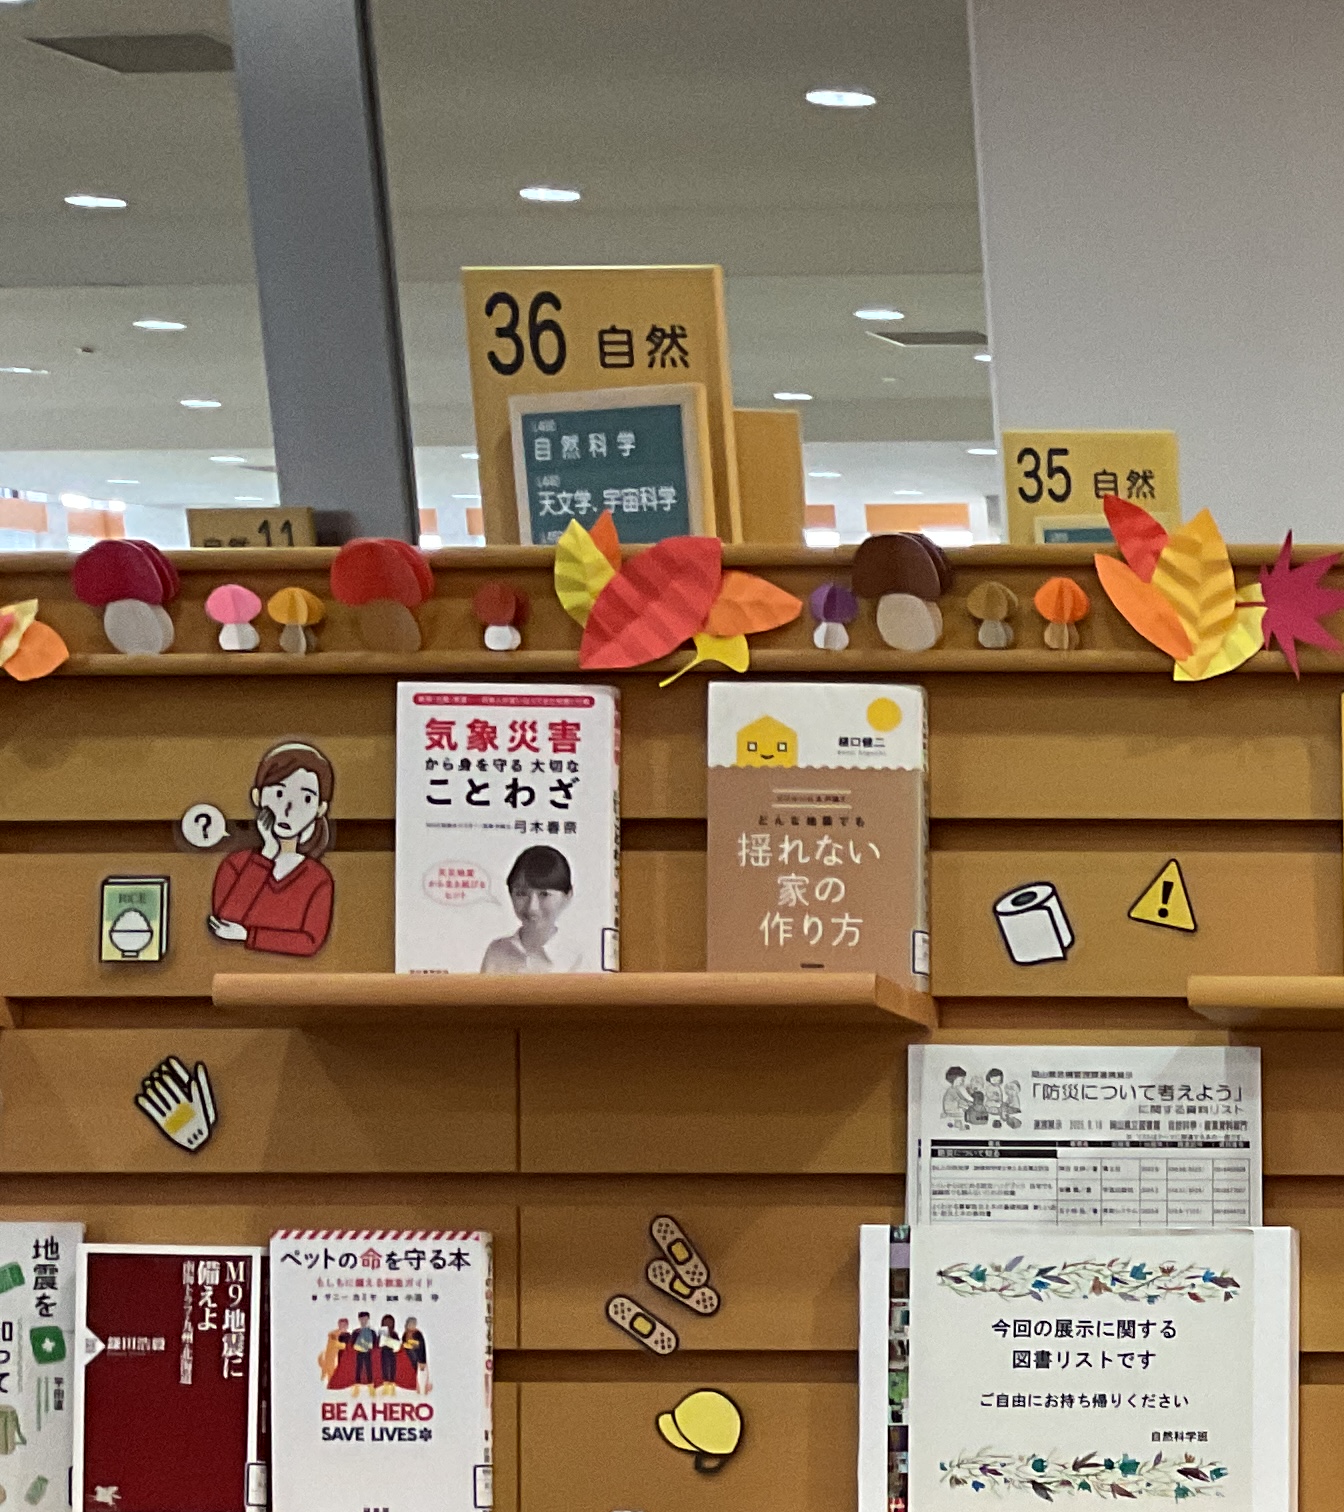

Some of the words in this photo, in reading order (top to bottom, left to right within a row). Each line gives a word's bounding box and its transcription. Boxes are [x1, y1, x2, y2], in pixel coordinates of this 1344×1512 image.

[484, 291, 567, 376] 36
[598, 324, 691, 370] 自然
[533, 432, 637, 462] 自然科学
[1017, 447, 1071, 503] 35
[1094, 470, 1155, 499] 自然
[425, 718, 581, 753] 気象災害
[531, 758, 580, 773] 大切な
[425, 778, 580, 809] ことわざ
[737, 833, 881, 867] 揺れない
[777, 873, 846, 907] 家の
[759, 912, 863, 949] 作り方
[1032, 1083, 1244, 1103] 「防災について考えよう」
[280, 1248, 471, 1271] ペットの命を守る本
[33, 1236, 59, 1318] 地震を
[197, 1260, 220, 1331] 備えよ
[222, 1260, 245, 1379] M9地震に
[992, 1319, 1178, 1339] 今回の展示に関する
[1012, 1350, 1156, 1369] 図書リストです
[322, 1403, 348, 1421] BE
[352, 1403, 369, 1421] A
[372, 1403, 434, 1421] HERO
[980, 1393, 1189, 1409] ご自由にお持ち帰りください
[322, 1427, 364, 1442] SAVE
[372, 1427, 417, 1442] LIVES
